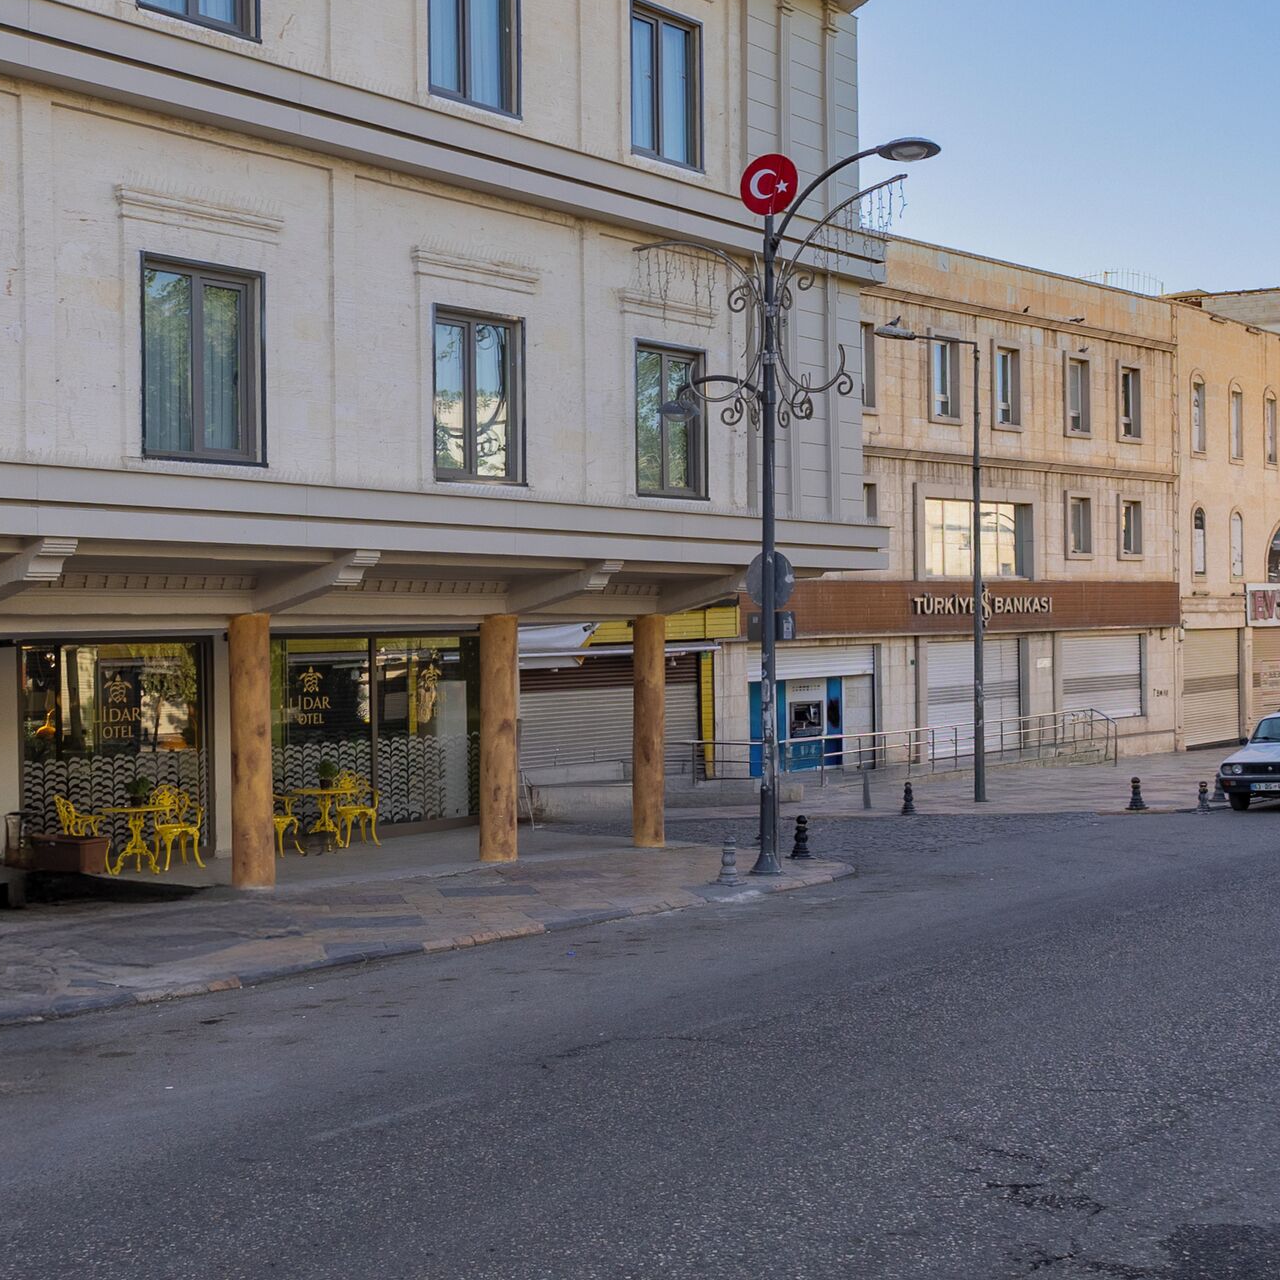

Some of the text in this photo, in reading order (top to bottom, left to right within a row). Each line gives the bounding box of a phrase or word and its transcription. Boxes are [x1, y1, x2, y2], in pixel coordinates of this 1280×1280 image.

[995, 596, 1053, 613] BANKASI
[1253, 590, 1276, 620] EV
[298, 713, 325, 725] OTEL
[103, 725, 135, 739] OTEL
